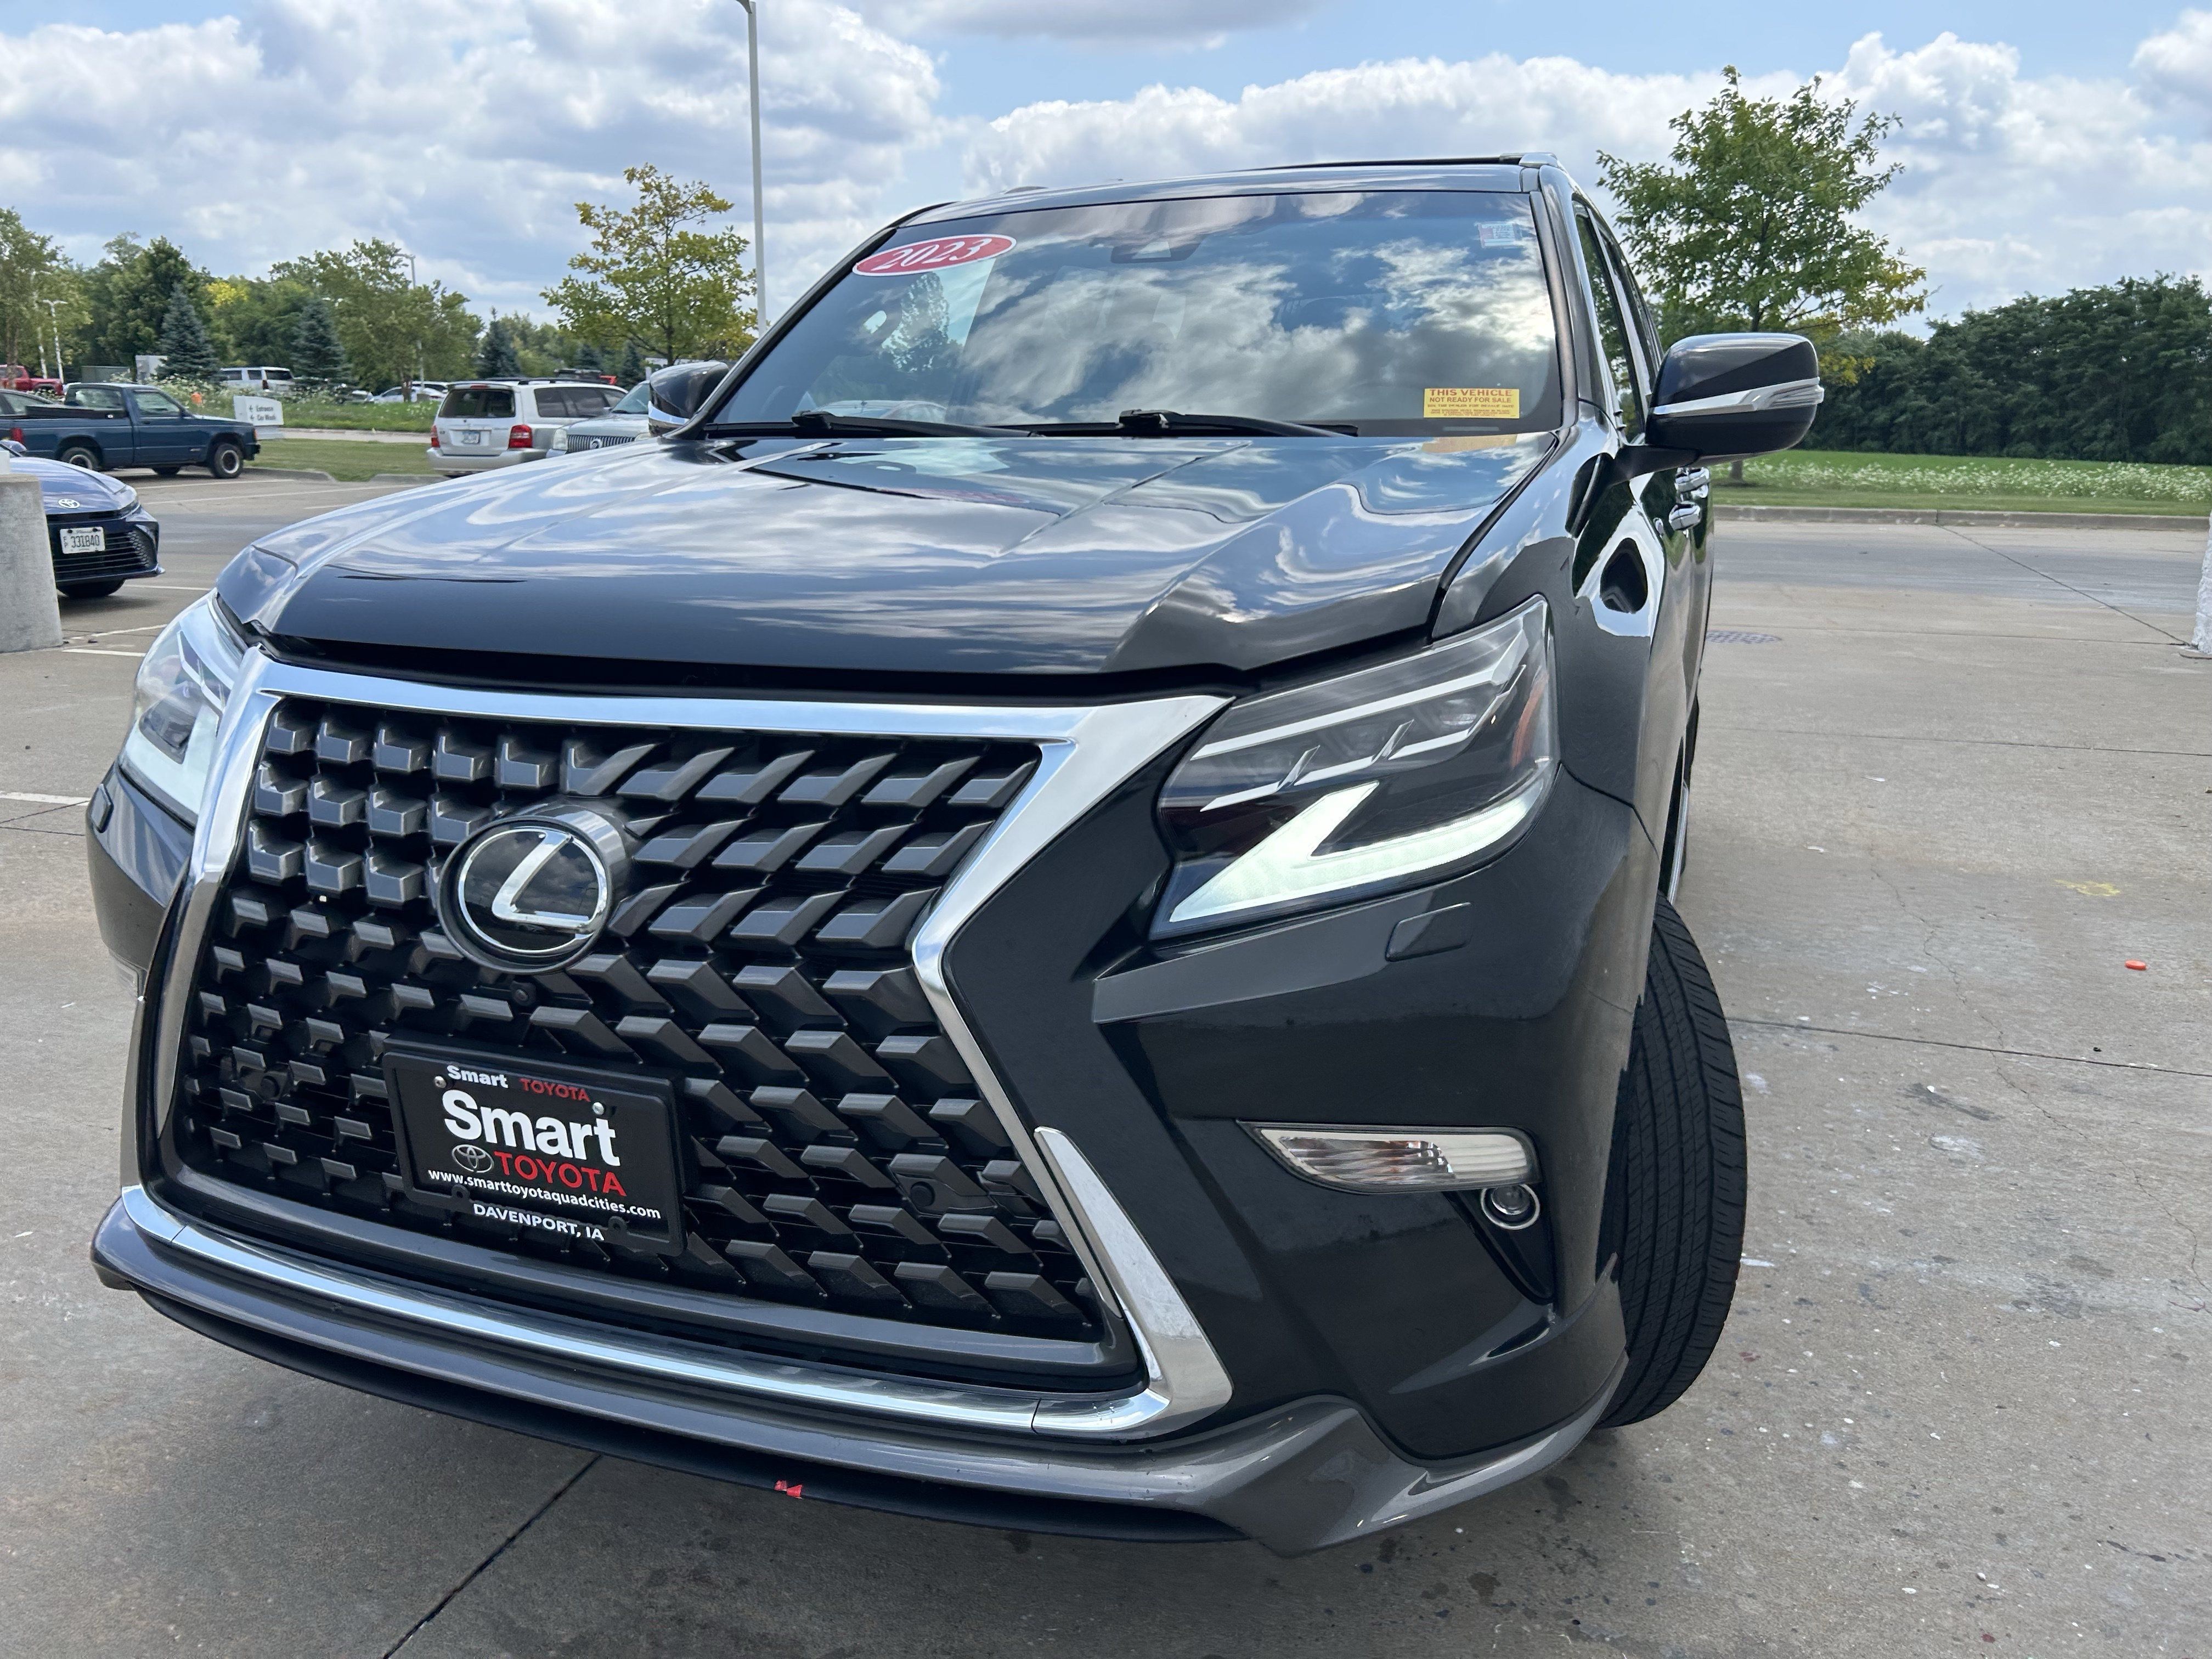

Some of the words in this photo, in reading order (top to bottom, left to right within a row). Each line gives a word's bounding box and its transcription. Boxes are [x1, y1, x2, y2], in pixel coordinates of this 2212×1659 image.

[871, 238, 992, 271] 2023
[447, 1065, 509, 1088] Smart
[519, 1077, 591, 1102] TOYOTA
[442, 1089, 621, 1166] Smart
[428, 1169, 661, 1219] www.smarttoyotaquadcities.com
[494, 1151, 627, 1197] TOYOTA
[473, 1203, 582, 1238] DAVENPORT,
[585, 1226, 605, 1241] IA
